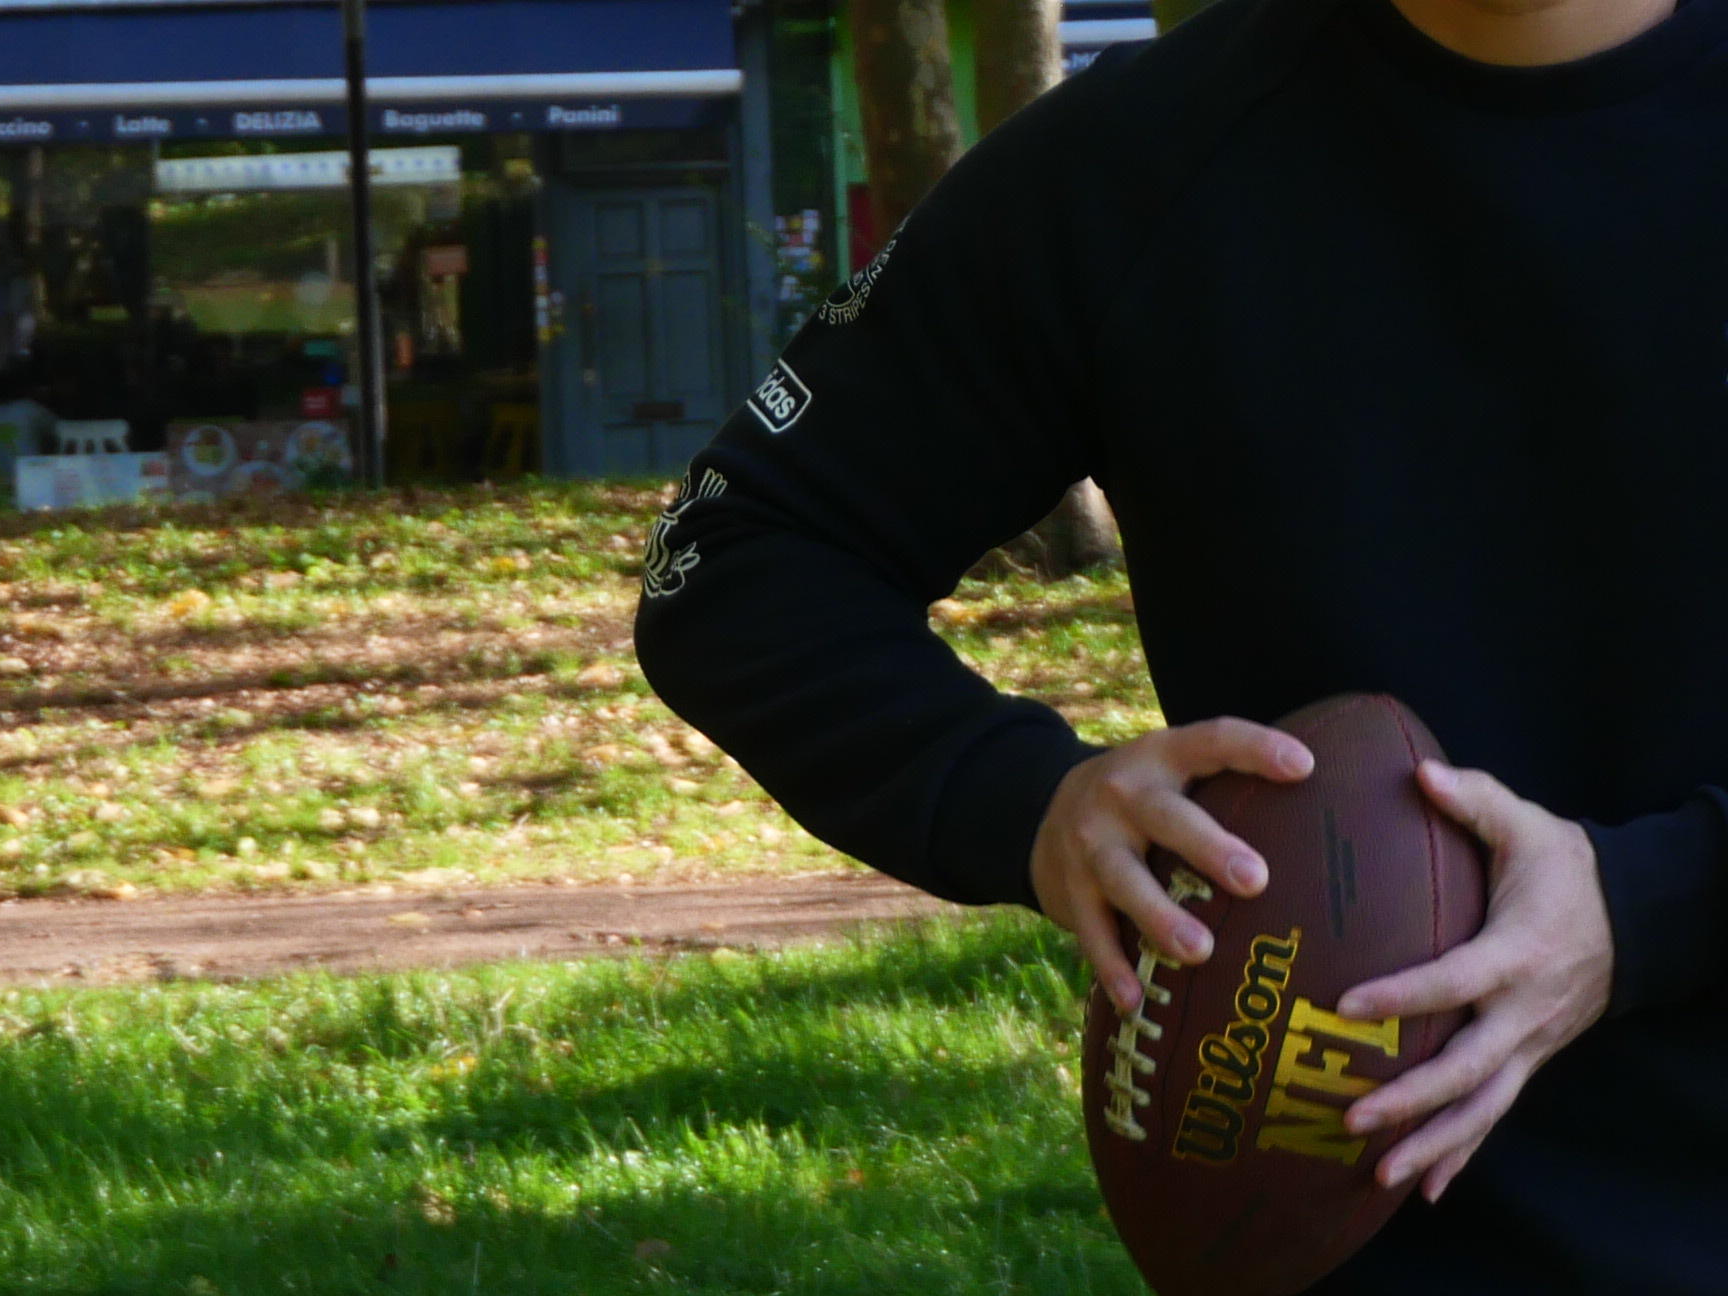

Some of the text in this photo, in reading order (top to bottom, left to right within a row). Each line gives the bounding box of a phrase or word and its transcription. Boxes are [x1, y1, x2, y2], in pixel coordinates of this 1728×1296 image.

[114, 112, 171, 134] Latte
[233, 110, 320, 133] DELIZIA
[383, 108, 485, 132] Baguette
[548, 105, 619, 125] Panini
[828, 282, 871, 325] STRIPES
[1173, 926, 1303, 1167] Wilson
